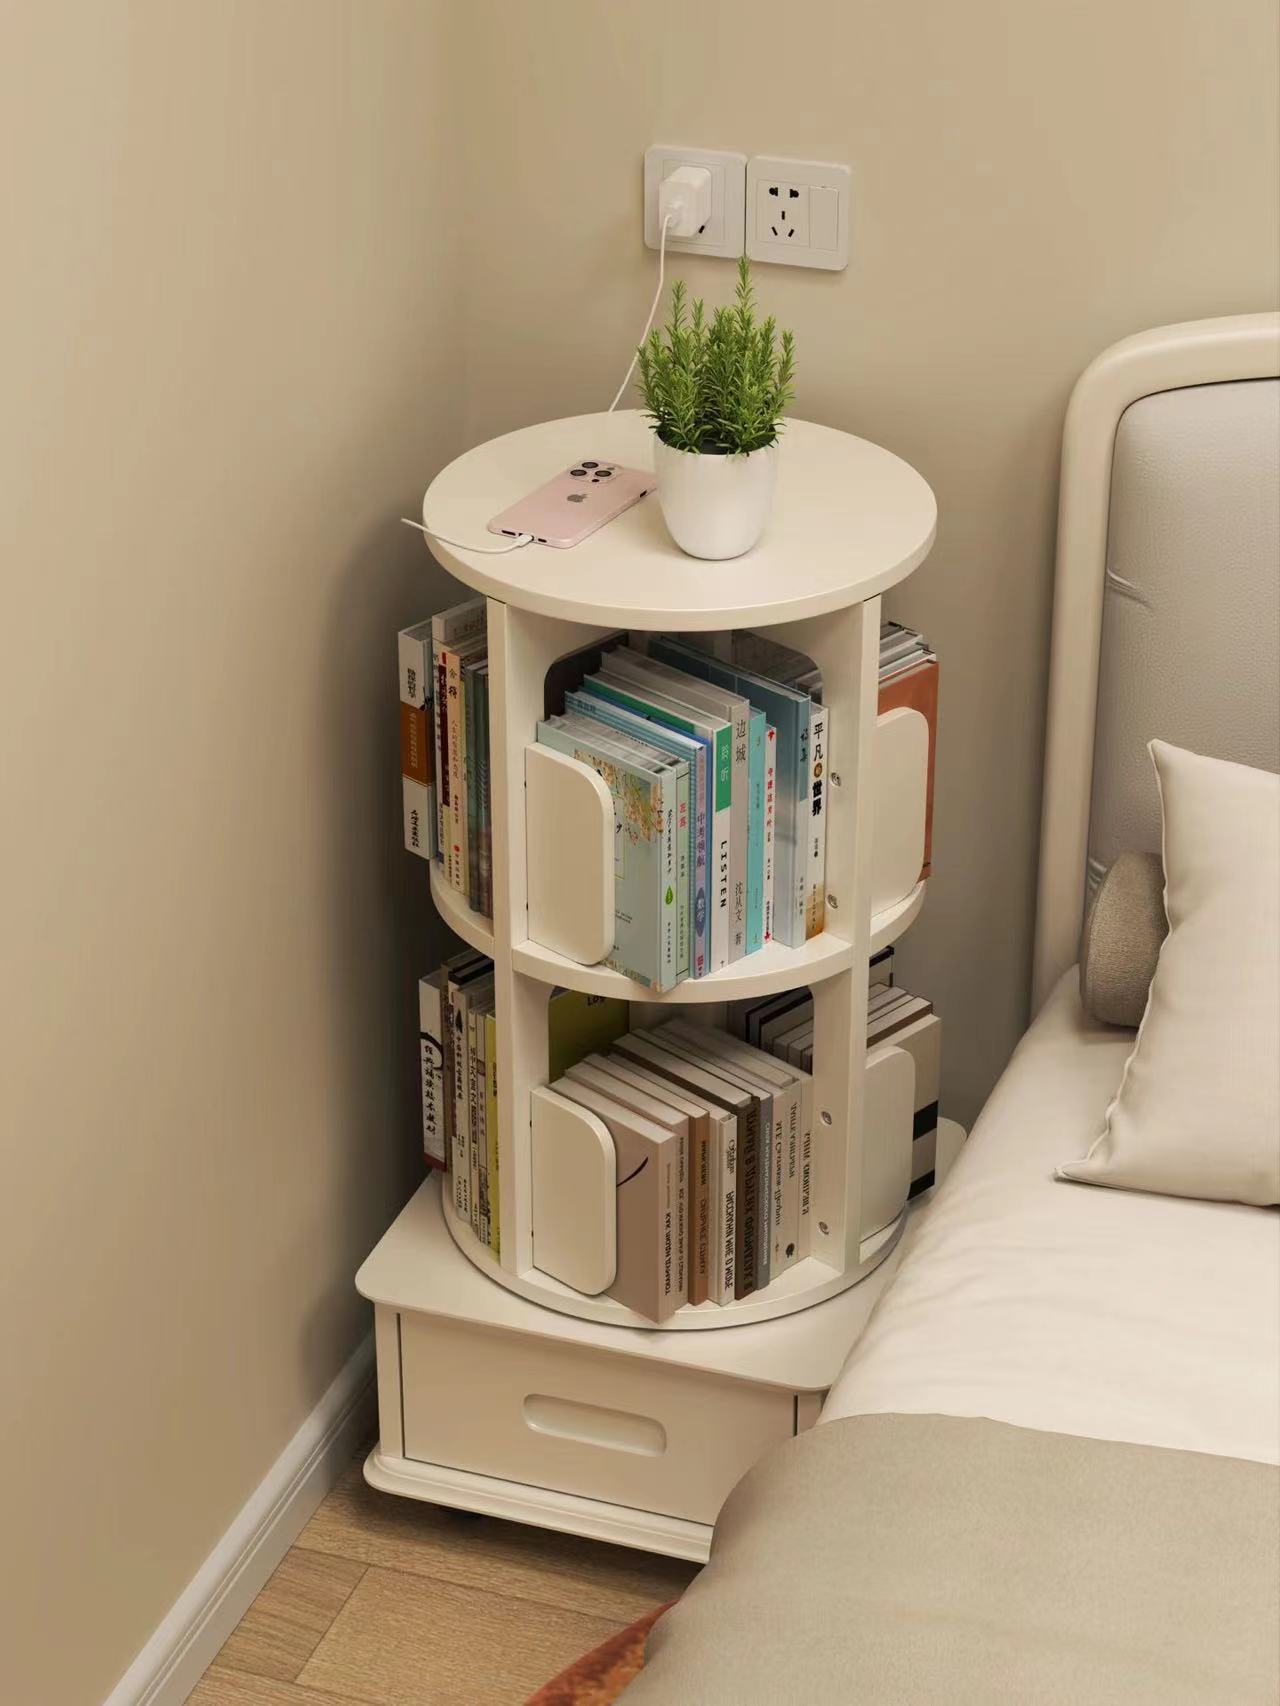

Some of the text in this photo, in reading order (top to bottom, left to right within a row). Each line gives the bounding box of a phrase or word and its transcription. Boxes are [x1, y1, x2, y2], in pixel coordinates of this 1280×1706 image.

[735, 719, 747, 764] 边城
[812, 722, 824, 817] 平凡的世界
[720, 840, 728, 908] LISTEN
